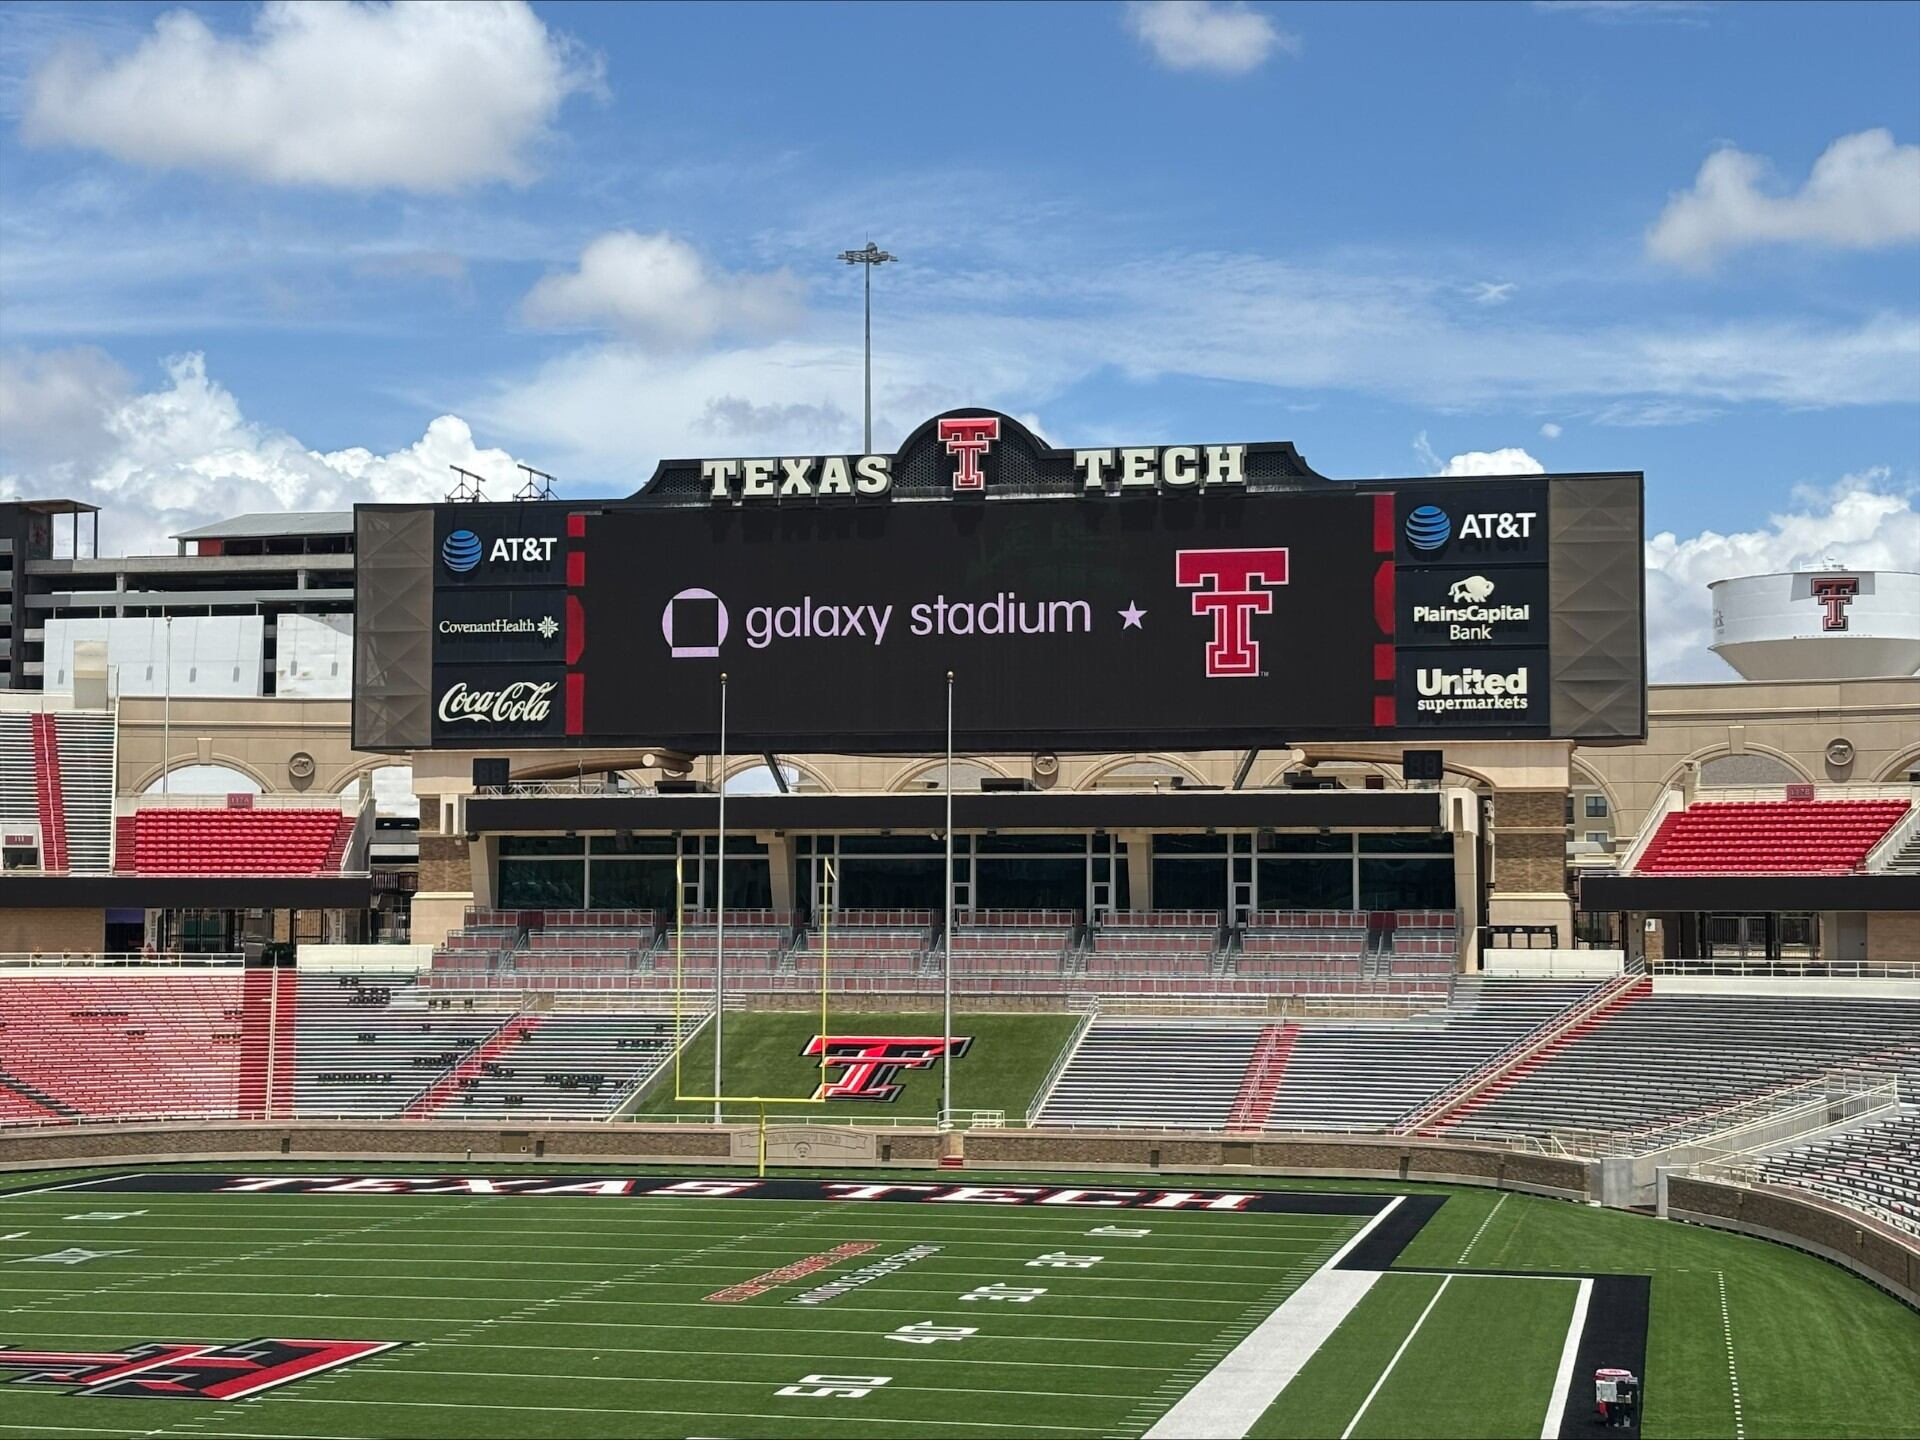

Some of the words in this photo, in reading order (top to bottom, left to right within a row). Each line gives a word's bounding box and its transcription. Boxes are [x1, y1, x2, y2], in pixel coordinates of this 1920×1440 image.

[702, 456, 889, 496] TEXAS
[1075, 446, 1245, 488] TECH
[1459, 512, 1537, 539] AT&T
[489, 537, 557, 562] AT&T
[745, 596, 893, 649] galaxy
[910, 592, 1092, 635] stadium
[1413, 604, 1530, 623] PlainsCapital
[1449, 624, 1493, 640] Bank
[1416, 667, 1528, 697] United
[438, 681, 558, 722] Coca-Cola
[1417, 695, 1528, 713] supermarkets
[218, 1176, 765, 1198] TEXAS
[820, 1182, 1263, 1211] TECH
[773, 1374, 893, 1398] 50
